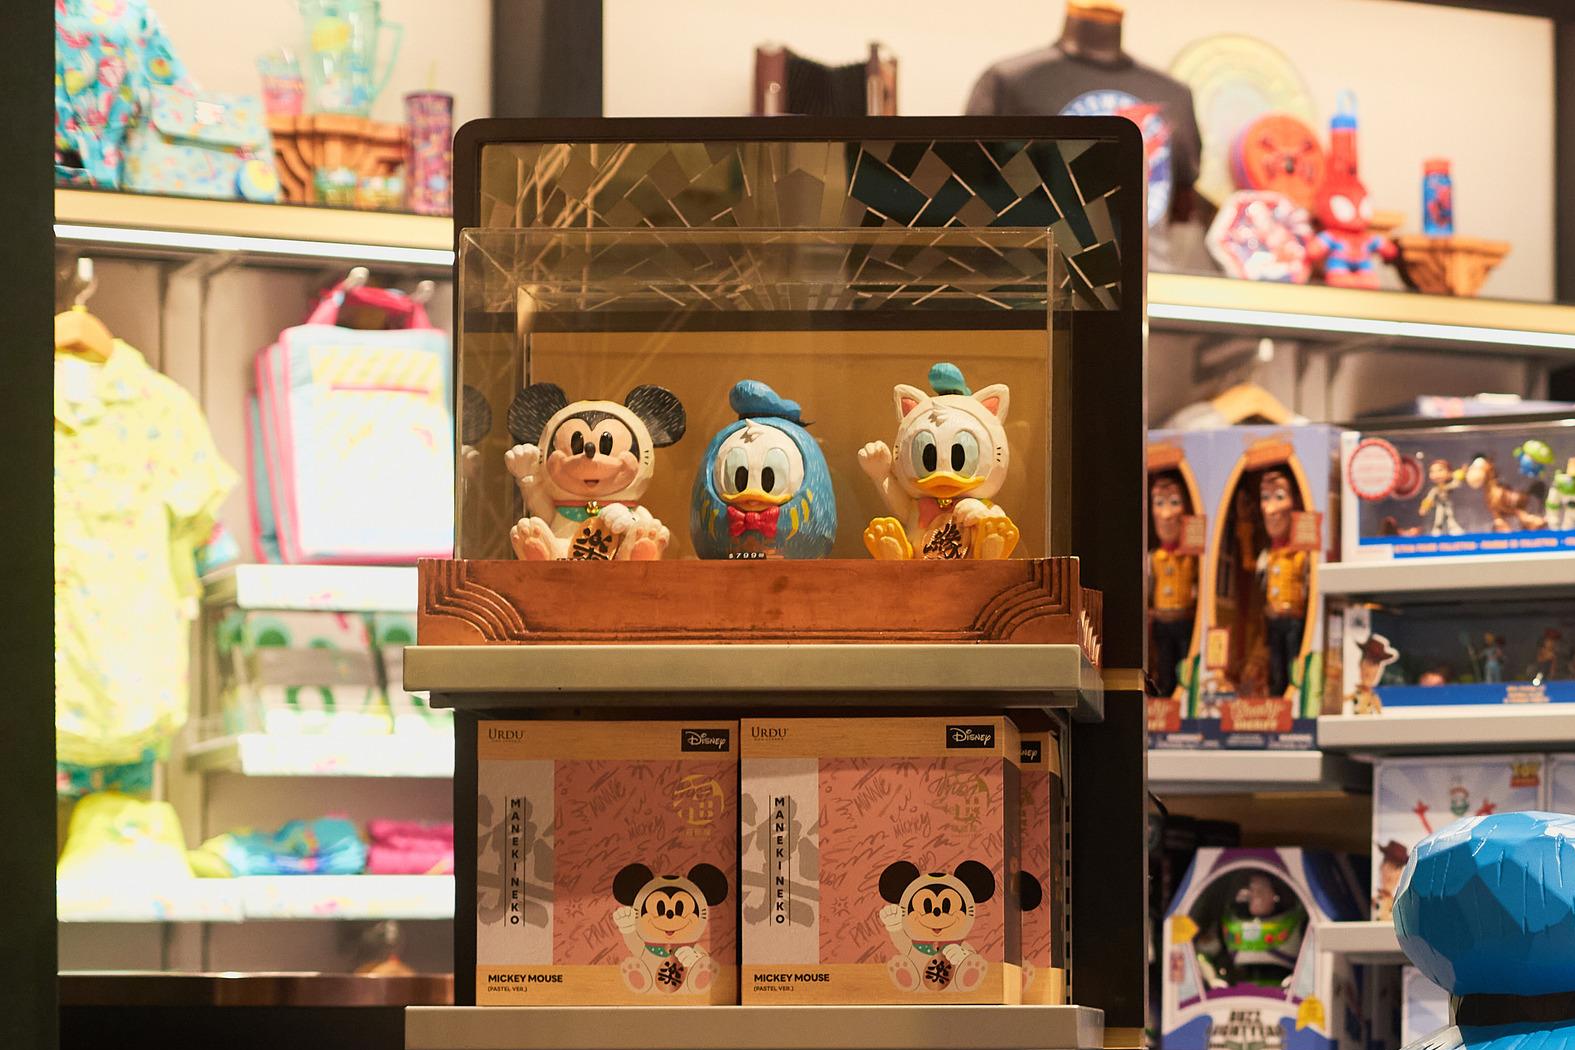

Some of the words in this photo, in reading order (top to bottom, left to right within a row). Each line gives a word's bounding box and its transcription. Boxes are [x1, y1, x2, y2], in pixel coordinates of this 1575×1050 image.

[488, 727, 524, 740] URDU
[751, 726, 787, 738] URDU
[949, 727, 992, 746] Disney
[685, 731, 727, 749] Disney
[510, 798, 521, 925] MANEKINEKO
[774, 797, 785, 924] MANEKINEKO
[488, 974, 526, 983] MICKEY
[528, 974, 563, 983] MOUSE
[754, 973, 793, 983] MICKEY
[795, 973, 830, 983] MOUSE
